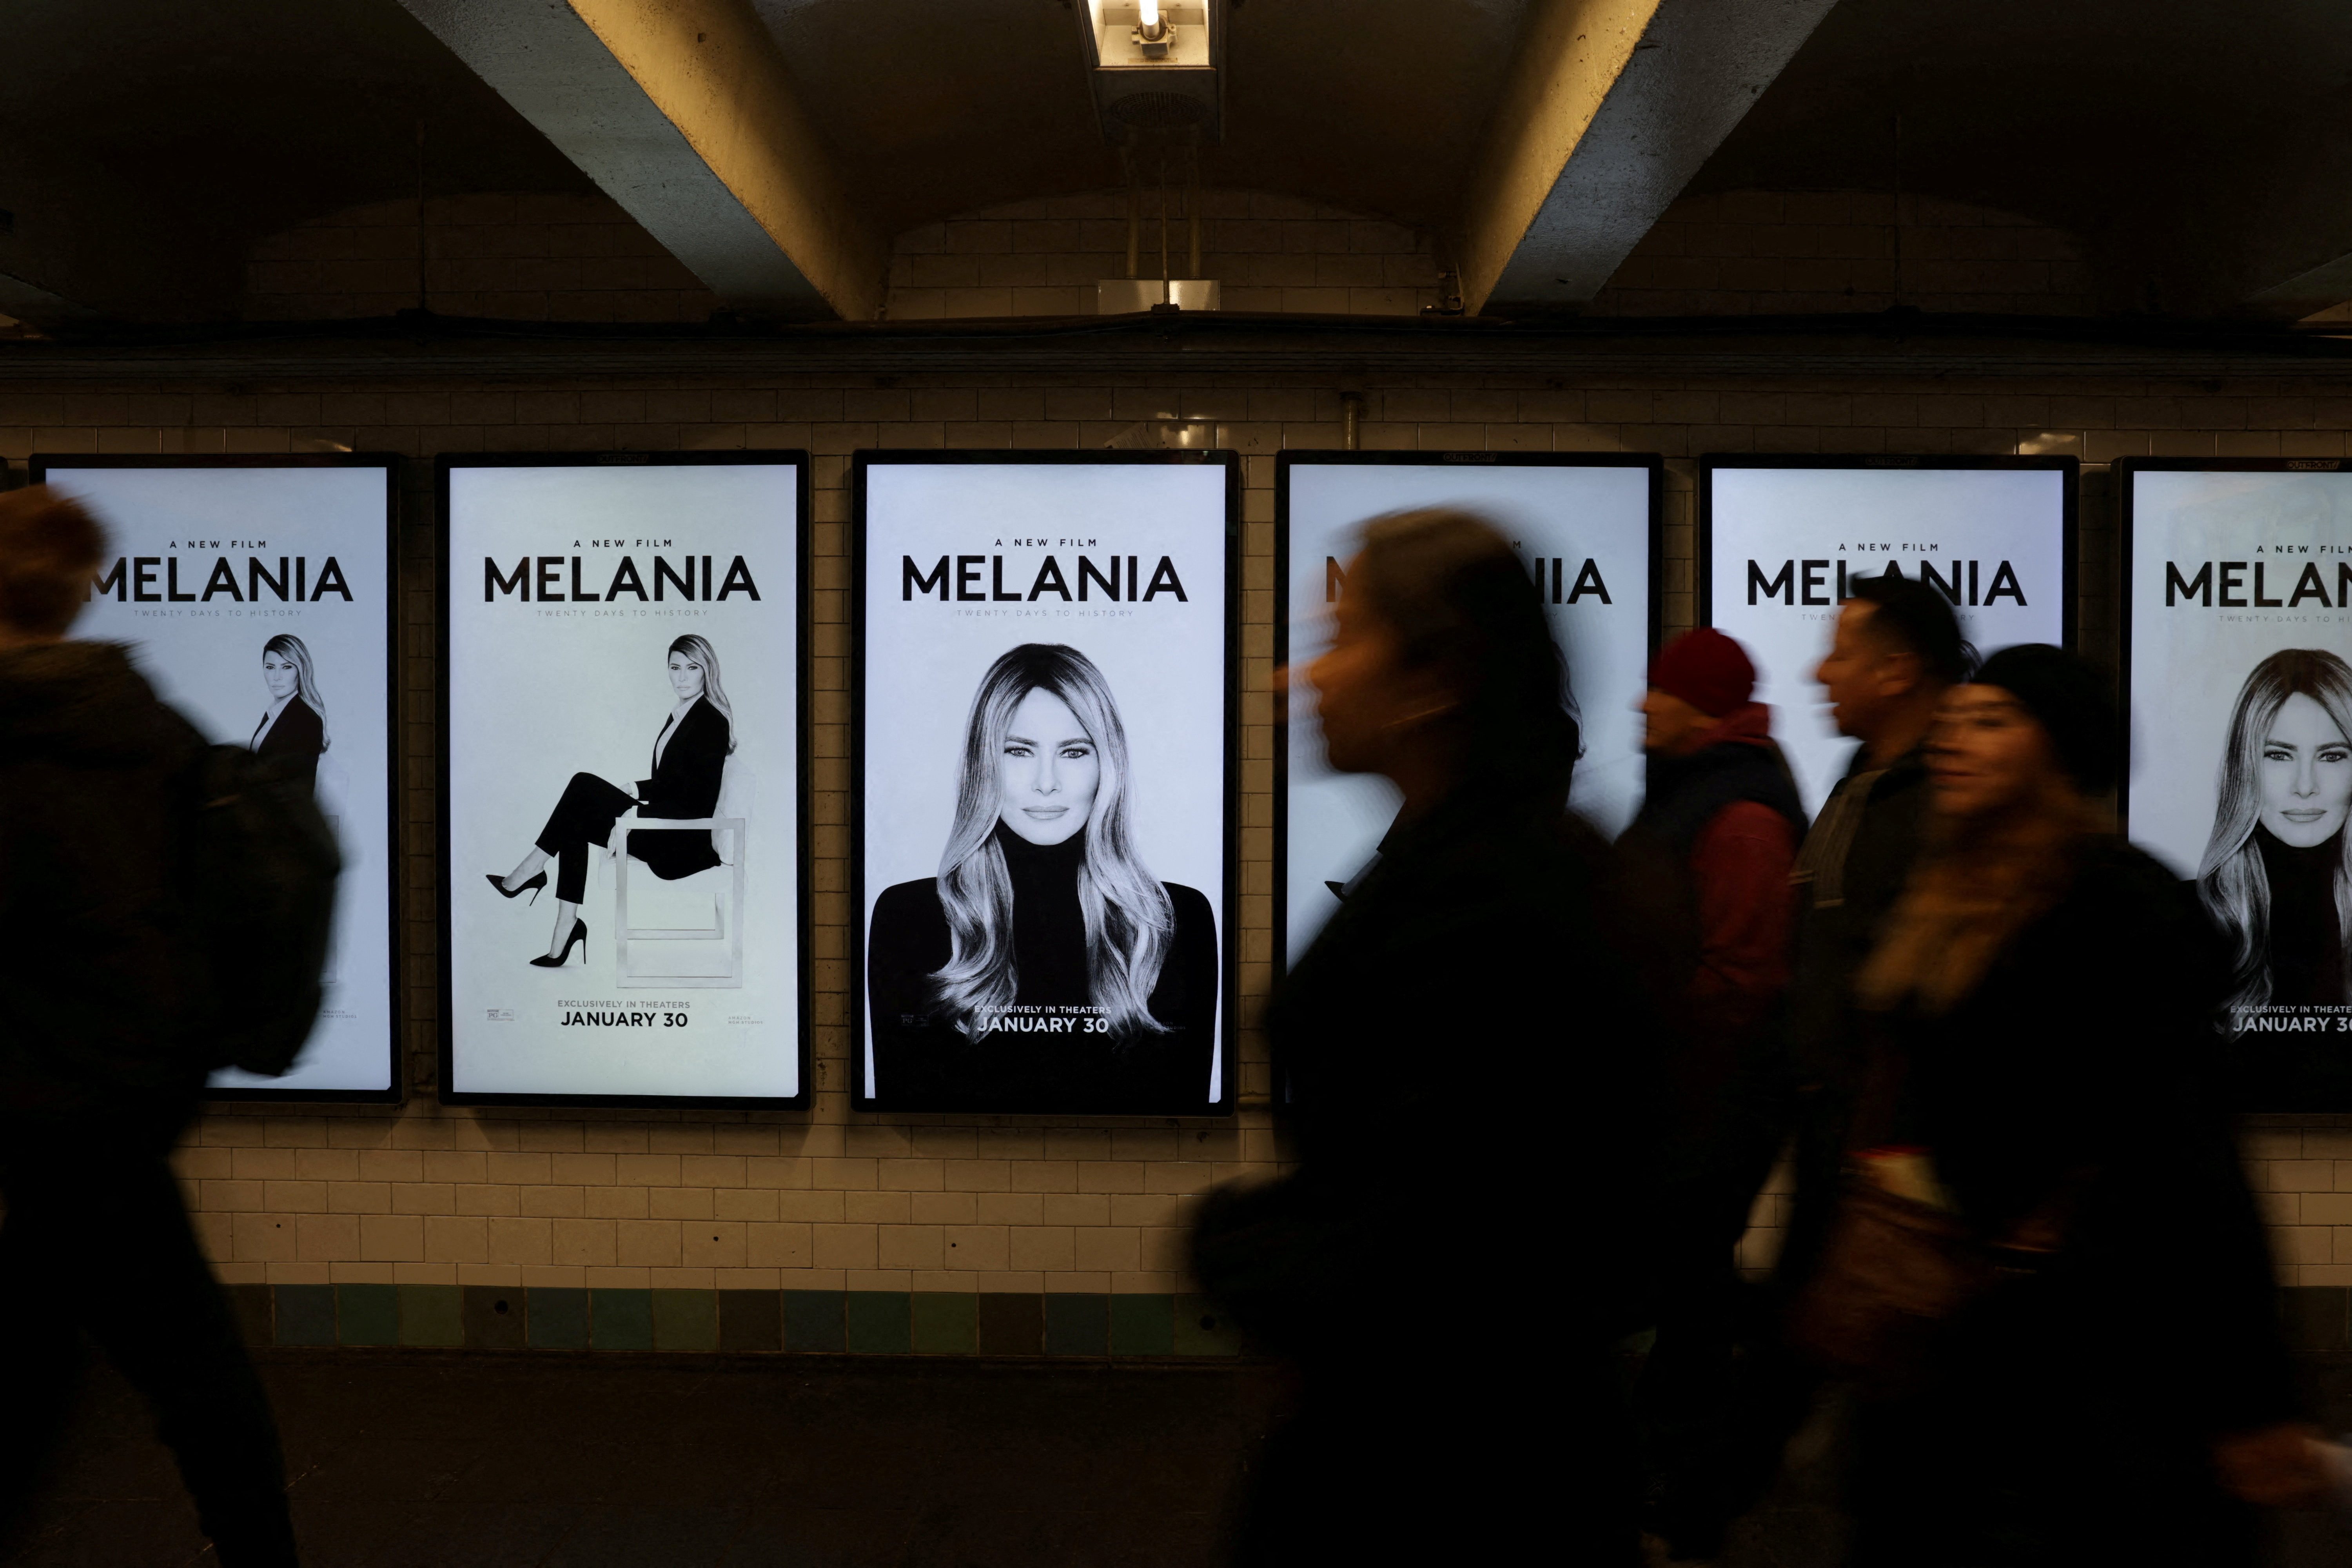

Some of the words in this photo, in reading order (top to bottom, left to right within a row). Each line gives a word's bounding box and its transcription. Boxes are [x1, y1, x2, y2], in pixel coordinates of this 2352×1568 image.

[82, 557, 354, 602] MELANIA
[485, 555, 761, 602] MELANIA
[903, 555, 1188, 602] MELANIA
[561, 1012, 656, 1026] JANUARY
[664, 1013, 688, 1027] 30
[977, 1017, 1076, 1032] JANUARY
[1083, 1018, 1109, 1033] 30
[2233, 1017, 2330, 1031] JANUARY
[2337, 1017, 2352, 1031] 3
